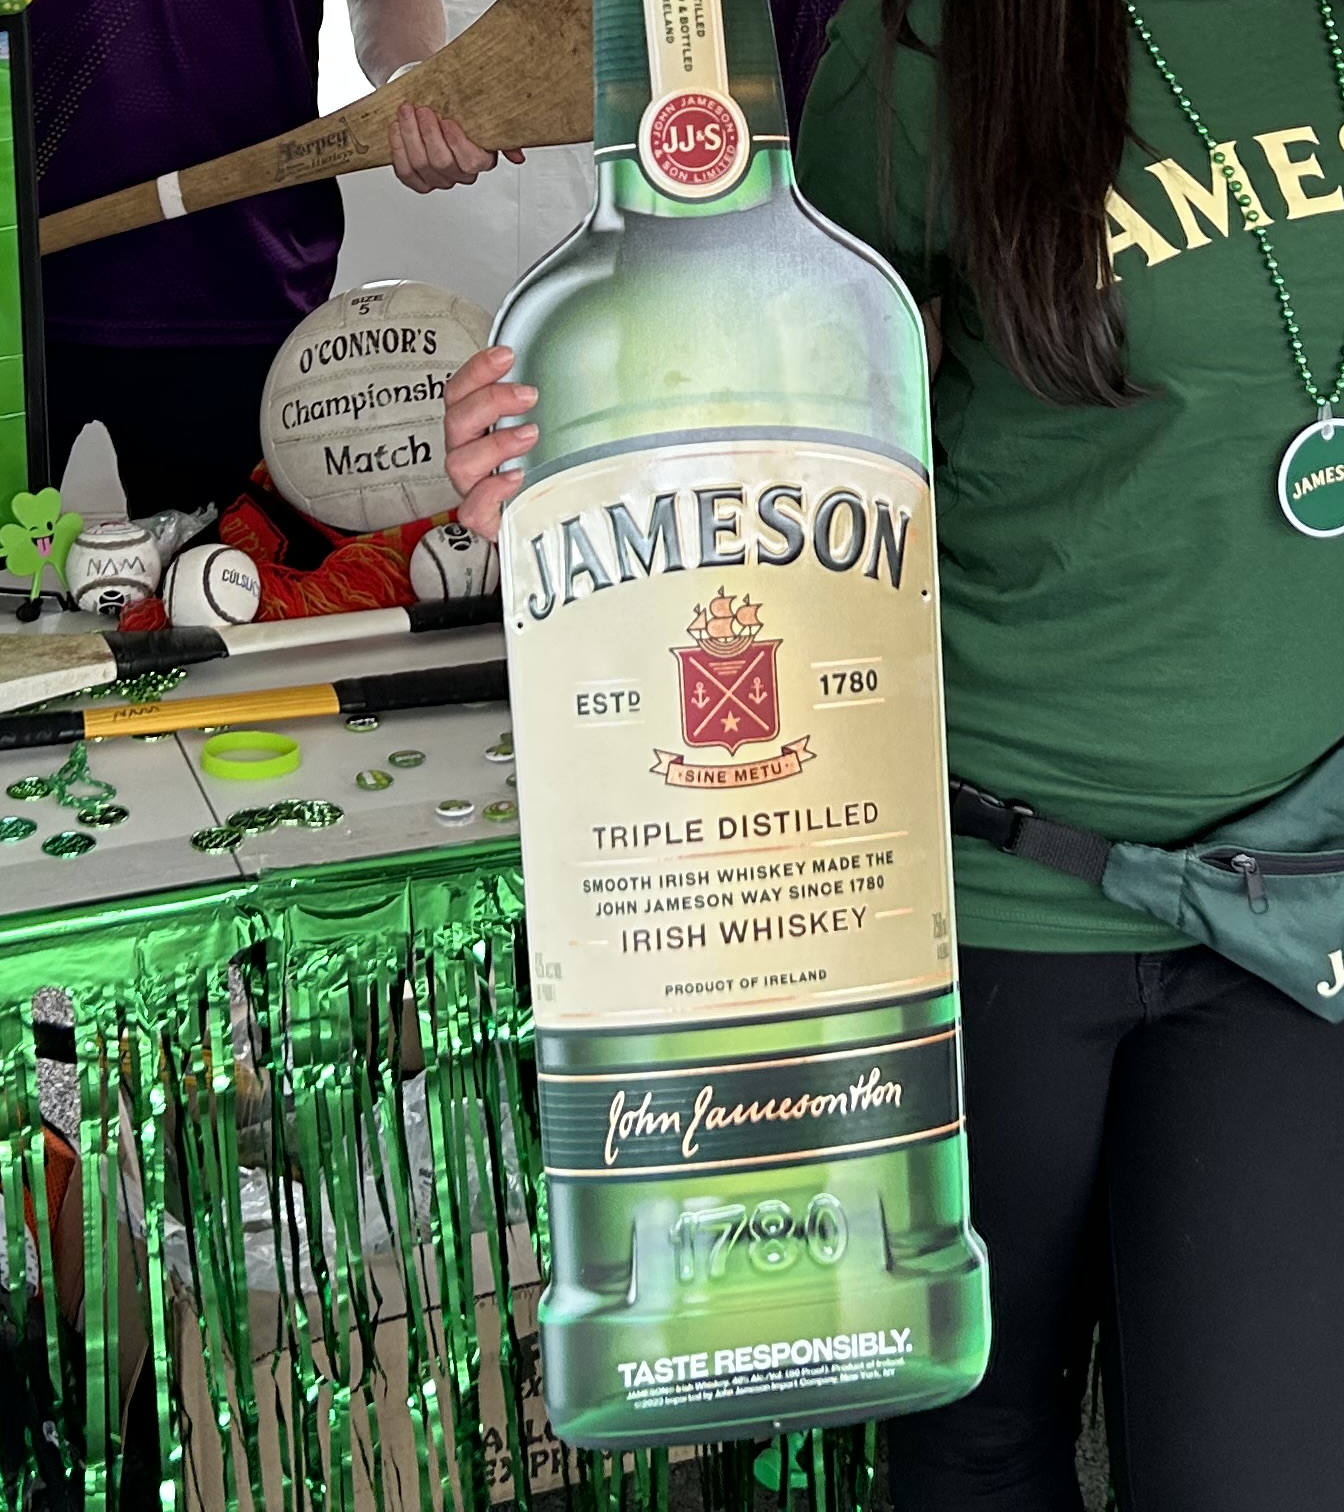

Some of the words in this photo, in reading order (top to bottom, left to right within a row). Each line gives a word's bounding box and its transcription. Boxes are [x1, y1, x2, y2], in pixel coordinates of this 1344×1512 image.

[679, 16, 693, 73] BOTTLED
[653, 104, 676, 138] JOHN
[680, 96, 735, 134] JAMESON
[662, 123, 722, 154] JJ&S
[661, 161, 689, 182] SON
[693, 144, 736, 183] LIMITED
[351, 293, 385, 306] SIZE
[358, 303, 371, 316] 5
[299, 327, 437, 374] O'CONNOR'S
[324, 434, 432, 476] Match
[527, 484, 911, 622] JAMESON
[819, 669, 879, 696] 1780
[684, 769, 727, 784] SINE
[734, 763, 783, 781] METU
[592, 818, 704, 850] TRIPLE
[719, 801, 879, 841] DISTILLED
[582, 875, 652, 894] SMOOTH
[658, 870, 710, 889] IRISH
[717, 861, 806, 883] WHISKEY
[812, 855, 860, 874] MADE
[866, 850, 894, 868] THE
[595, 900, 638, 917] JOHN
[644, 892, 734, 914] JAMESON
[741, 888, 783, 905] WAY
[788, 880, 844, 900] SINCE
[849, 875, 885, 893] 1780
[622, 922, 706, 953] IRISH
[719, 906, 868, 945] WHISKEY
[665, 979, 734, 996] PRODUCT
[740, 976, 758, 988] OF
[764, 969, 827, 987] IRELAND
[604, 1090, 681, 1167] John
[668, 1192, 848, 1284] 1780
[618, 1352, 709, 1388] TASTE
[714, 1327, 913, 1376] RESPONSIBLY.
